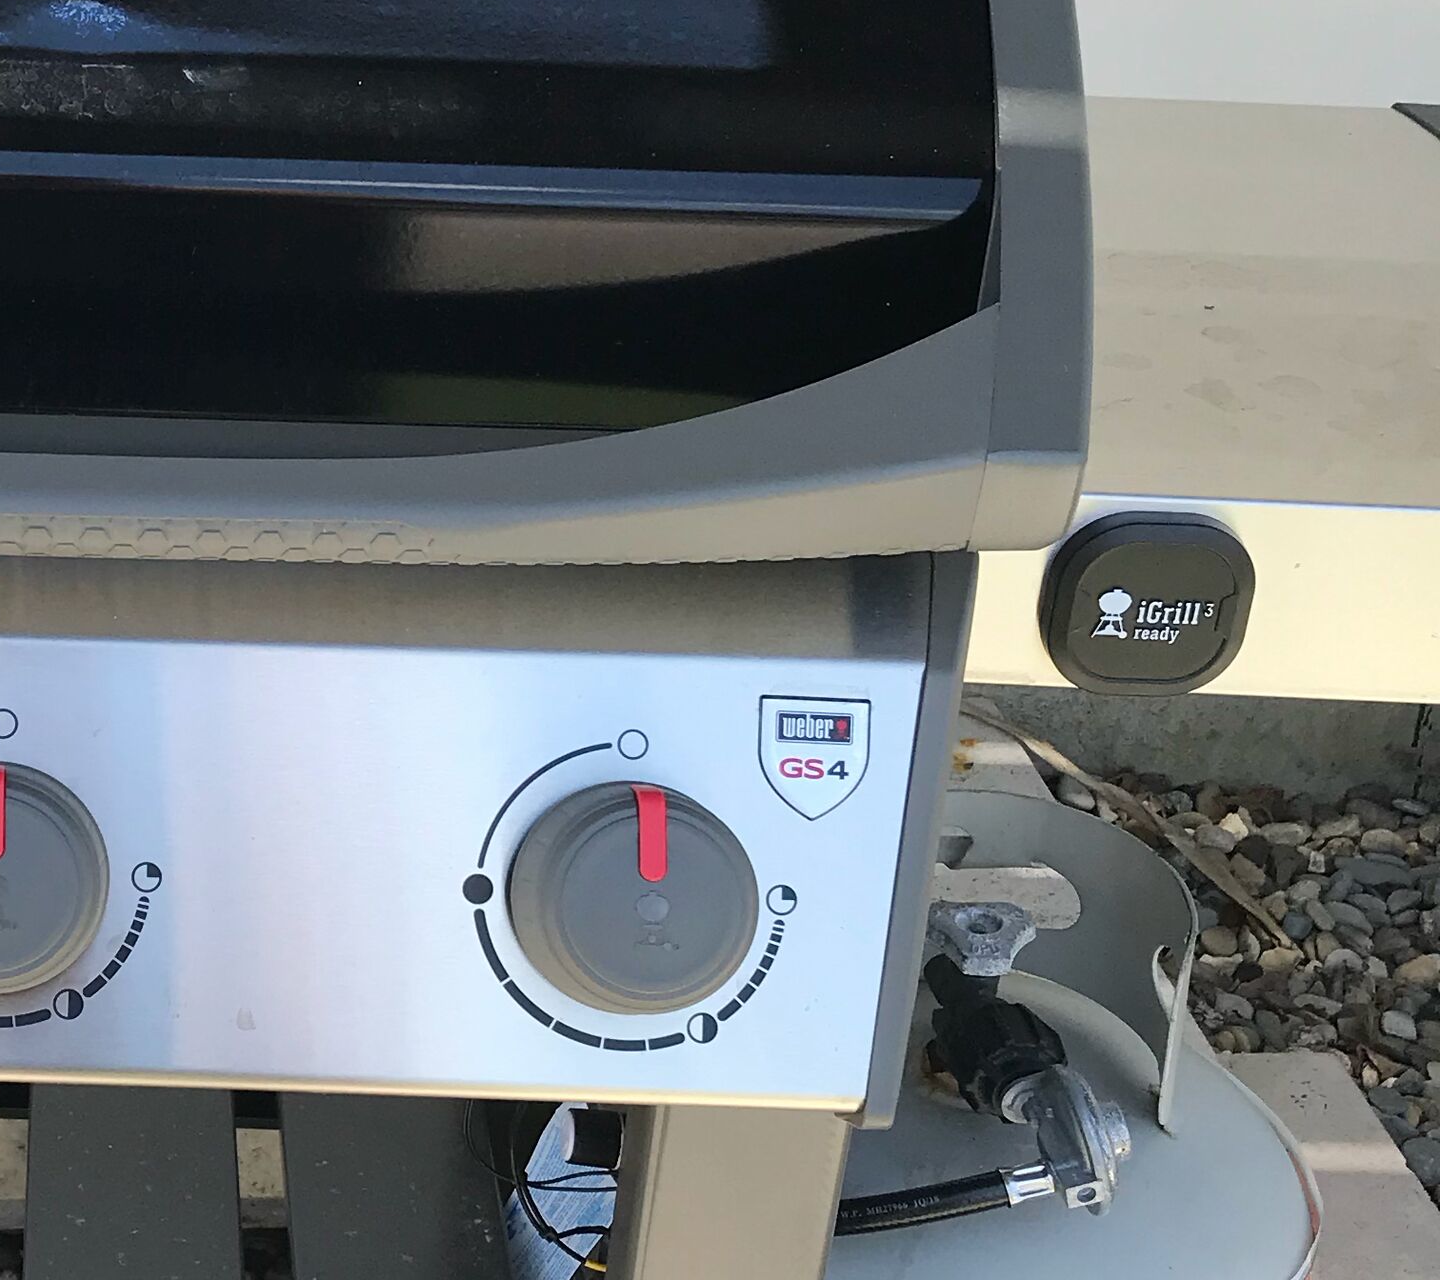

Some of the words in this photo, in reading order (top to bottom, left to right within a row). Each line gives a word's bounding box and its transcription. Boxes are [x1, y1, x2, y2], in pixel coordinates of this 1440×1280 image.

[1133, 627, 1180, 645] ready
[782, 714, 834, 740] weber
[778, 757, 850, 781] GS4
